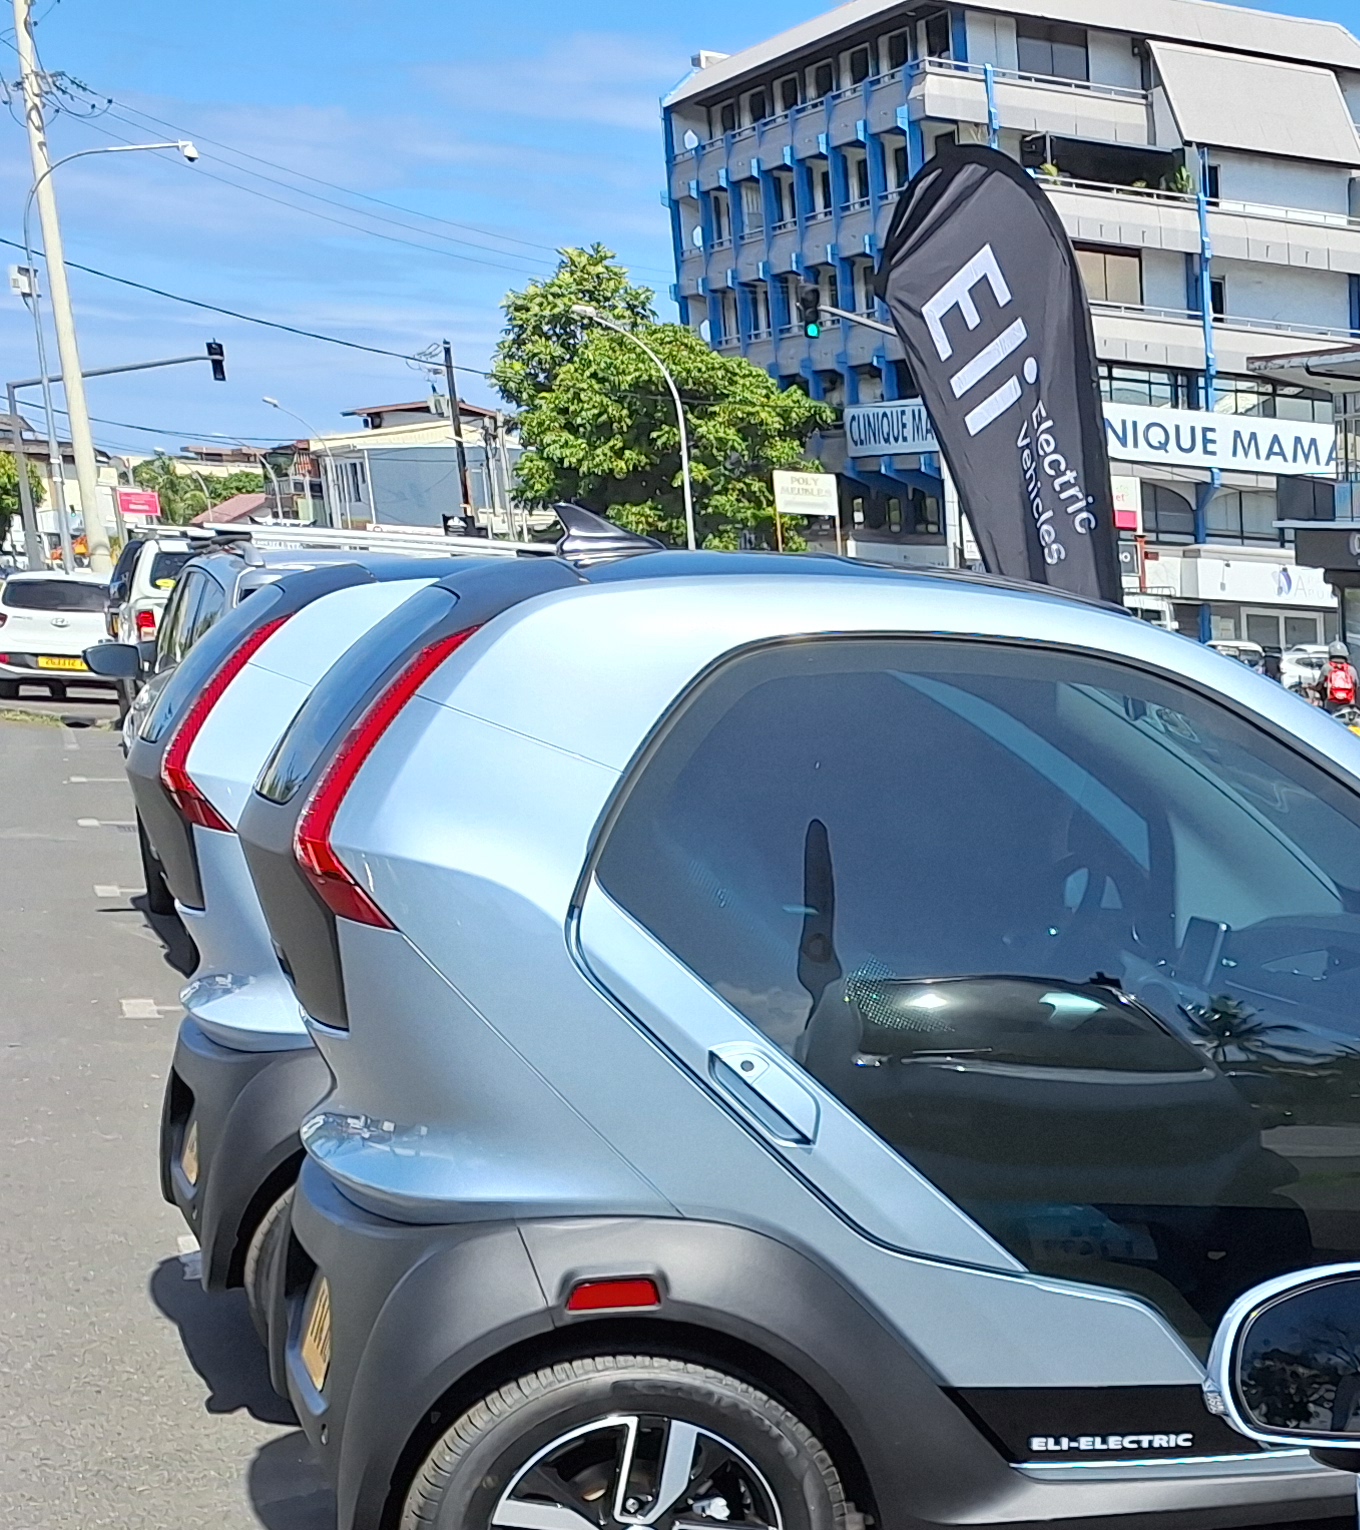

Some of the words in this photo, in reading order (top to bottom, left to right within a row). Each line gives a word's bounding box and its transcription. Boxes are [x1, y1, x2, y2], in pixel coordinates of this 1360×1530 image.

[921, 243, 1040, 437] Eli
[850, 409, 908, 447] CLINIQUE
[1016, 419, 1066, 566] Vehicles
[1030, 399, 1096, 535] Electric
[1031, 1433, 1193, 1451] ELI-ELECTRIC
